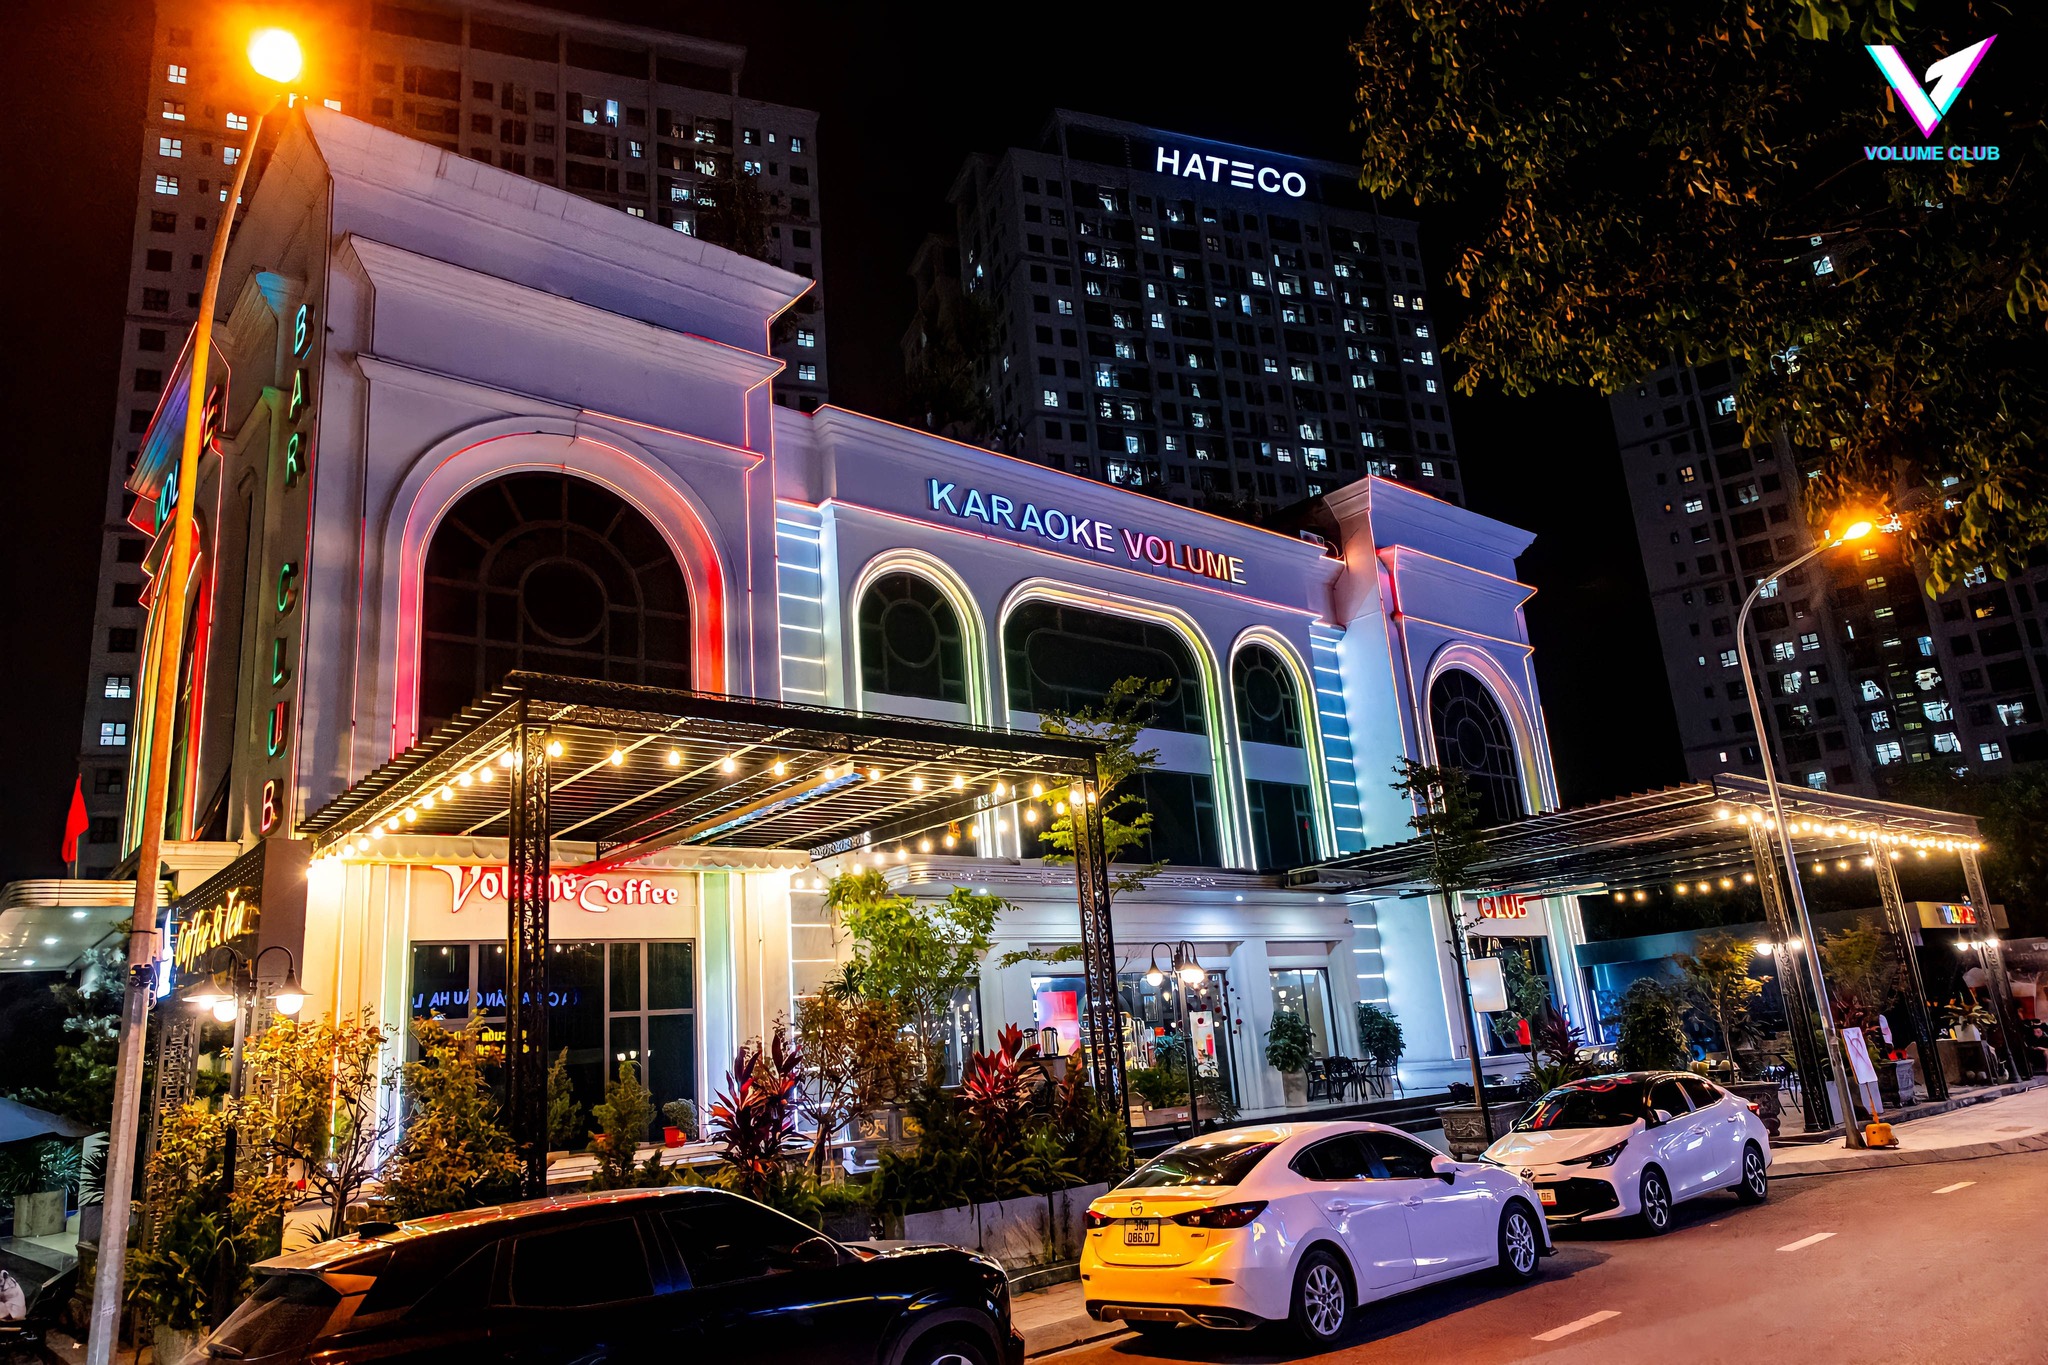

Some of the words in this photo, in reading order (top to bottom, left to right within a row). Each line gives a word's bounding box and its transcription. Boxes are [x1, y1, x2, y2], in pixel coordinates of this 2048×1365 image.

[1156, 146, 1307, 198] HATECO
[286, 303, 312, 487] BAR
[154, 384, 219, 536] VOLE
[927, 477, 1115, 553] KARAOKE
[1118, 527, 1248, 586] VOLUME
[260, 561, 297, 836] CLUB
[431, 865, 577, 914] Volme
[578, 878, 680, 913] Coffee
[1127, 1232, 1155, 1243] 086.07
